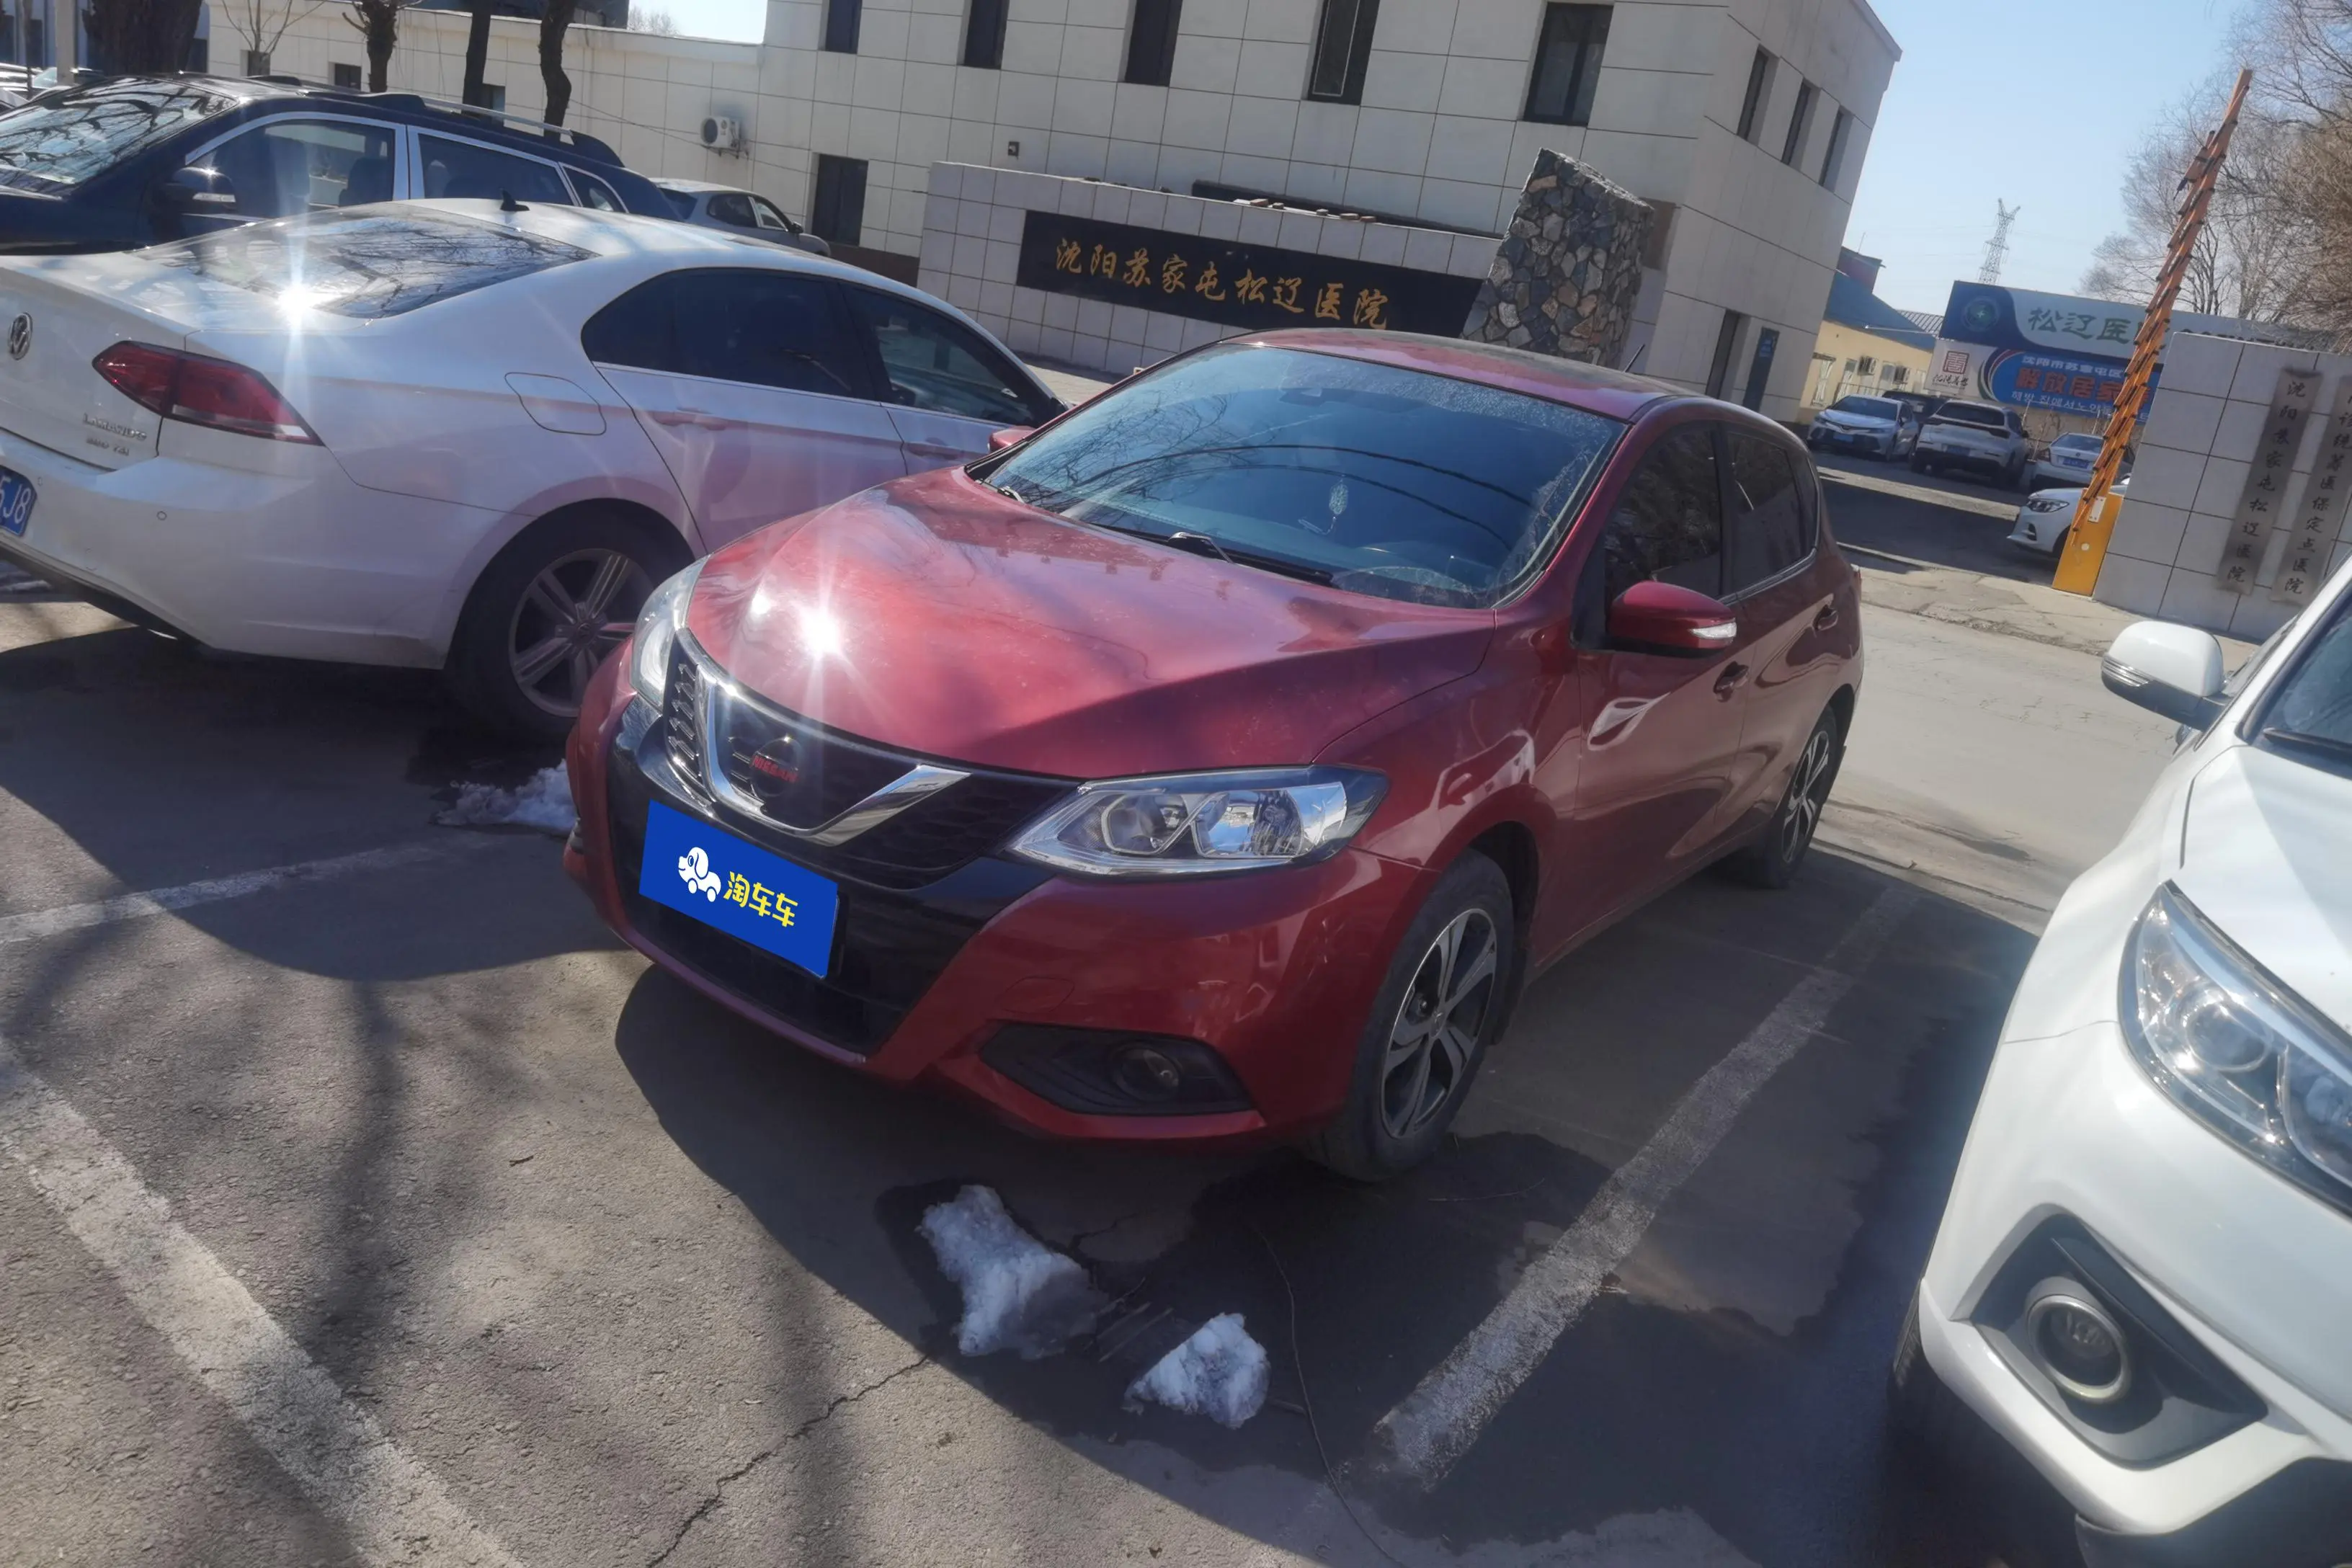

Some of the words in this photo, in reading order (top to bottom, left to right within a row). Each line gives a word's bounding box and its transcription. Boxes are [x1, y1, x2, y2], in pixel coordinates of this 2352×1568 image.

[1056, 236, 1389, 330] 沈阳苏家屯松辽医院
[2027, 306, 2147, 344] 松辽医
[2015, 366, 2151, 404] 解放居家
[2284, 394, 2352, 594] 诊统筹医保定点医院
[750, 755, 798, 783] NISSAN
